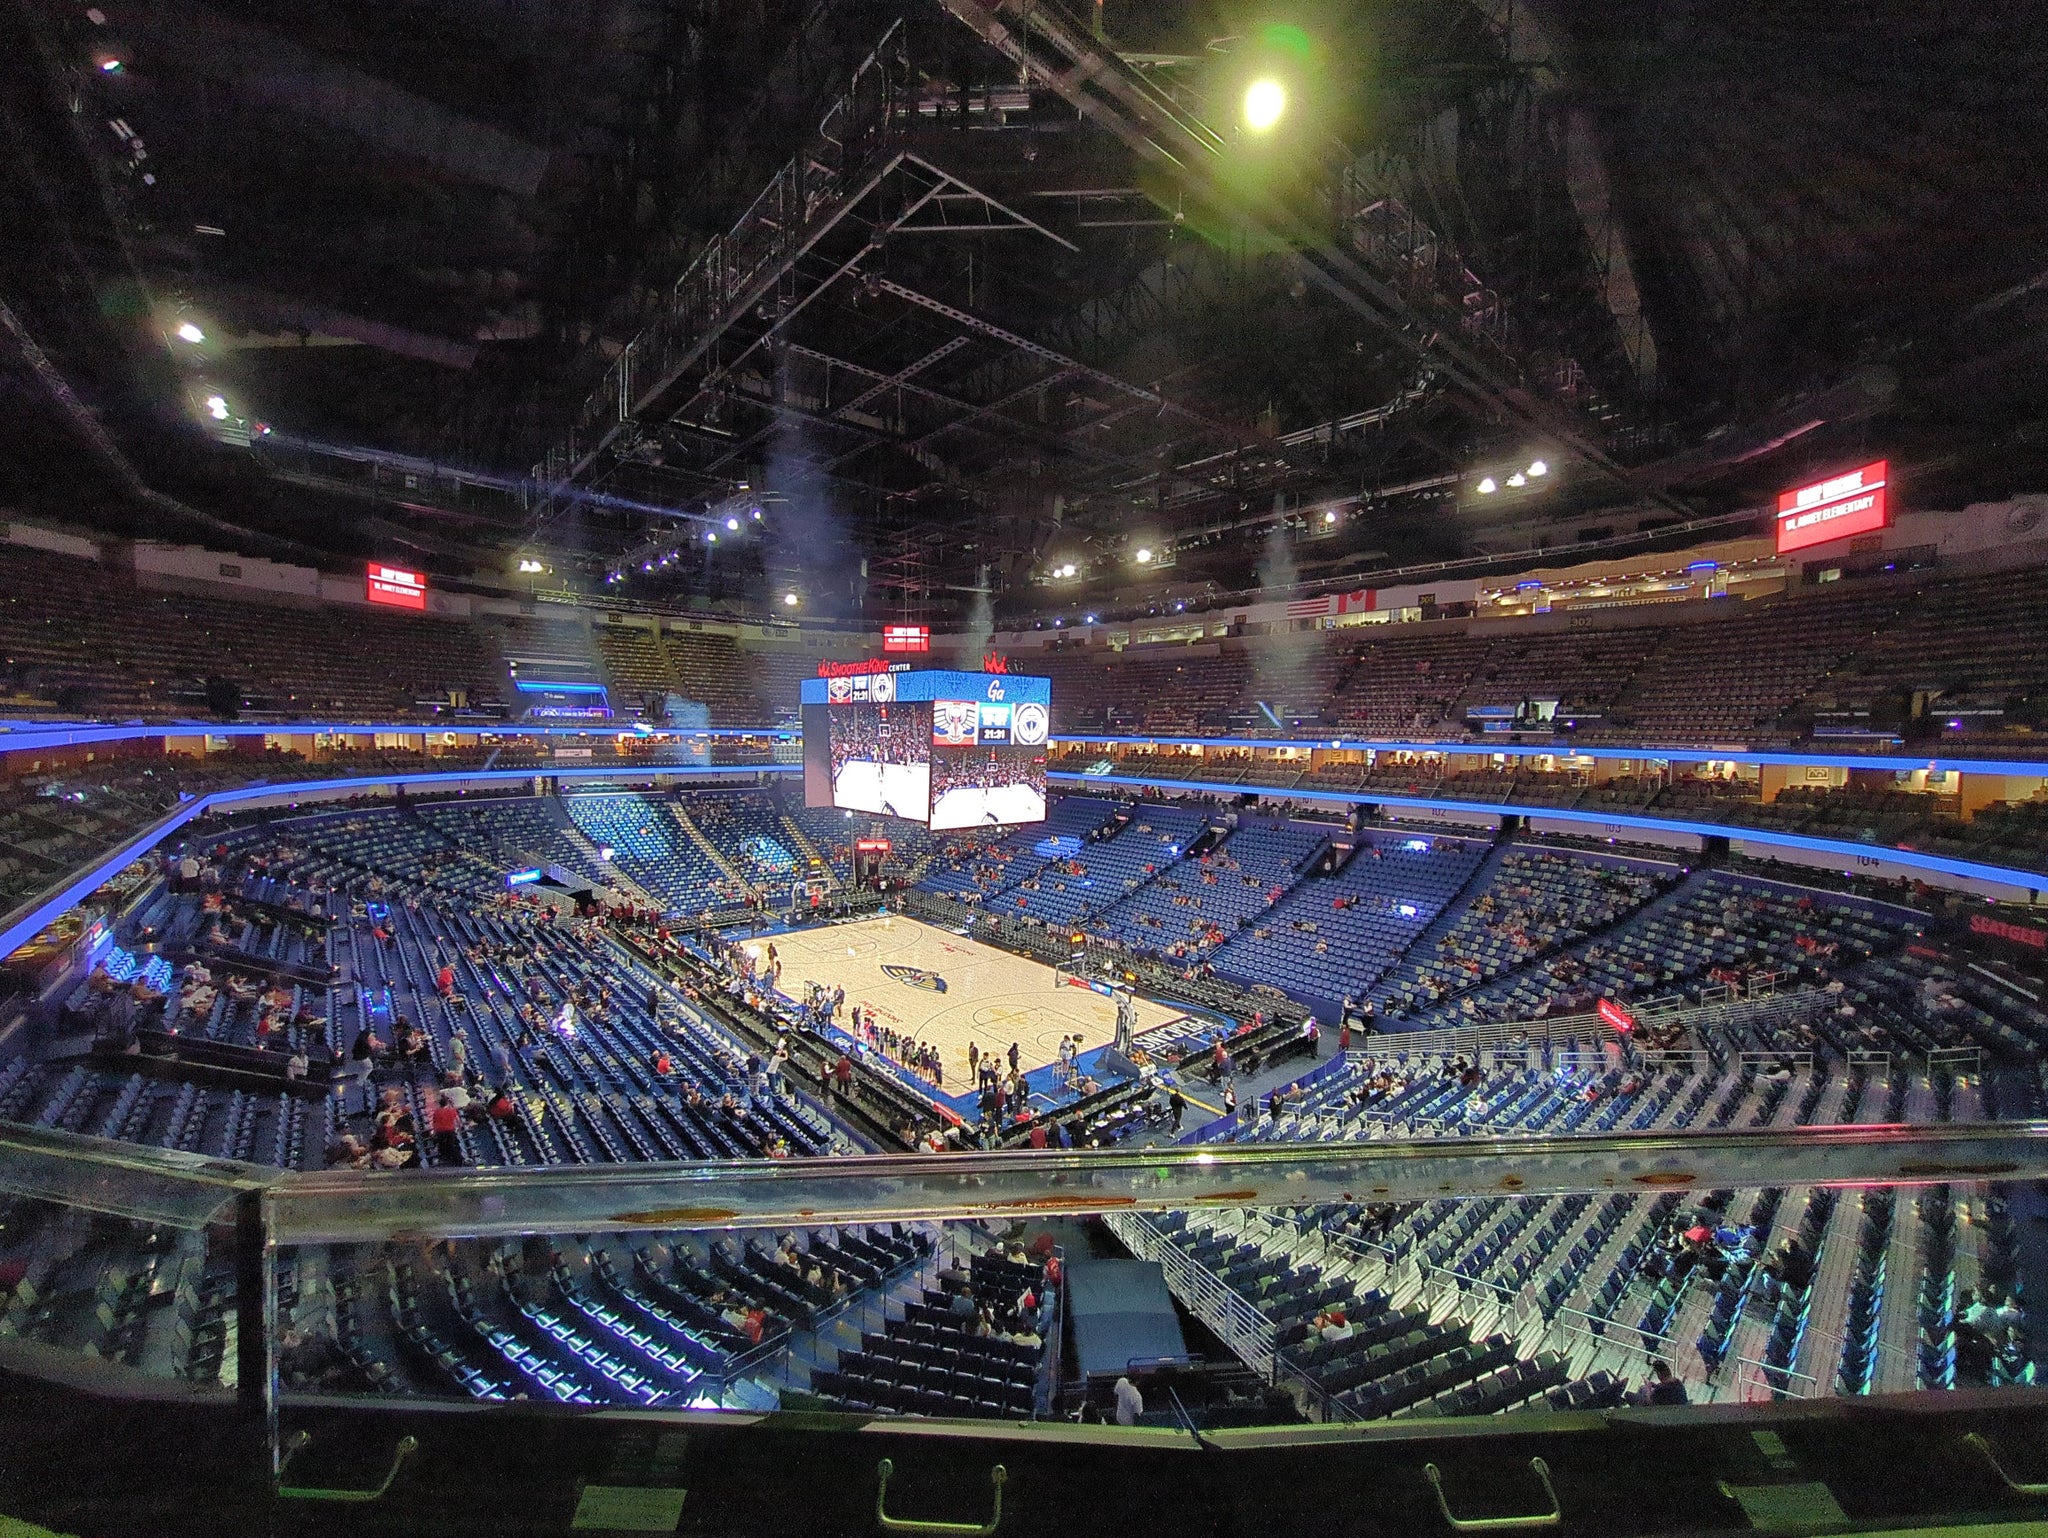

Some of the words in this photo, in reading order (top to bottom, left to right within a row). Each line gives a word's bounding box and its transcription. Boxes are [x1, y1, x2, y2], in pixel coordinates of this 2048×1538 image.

[830, 660, 869, 677] SMOOTHIE
[868, 656, 890, 674] KING
[888, 663, 911, 672] CENTER
[987, 679, 1006, 702] Ga
[1132, 1016, 1214, 1049] PELICANS
